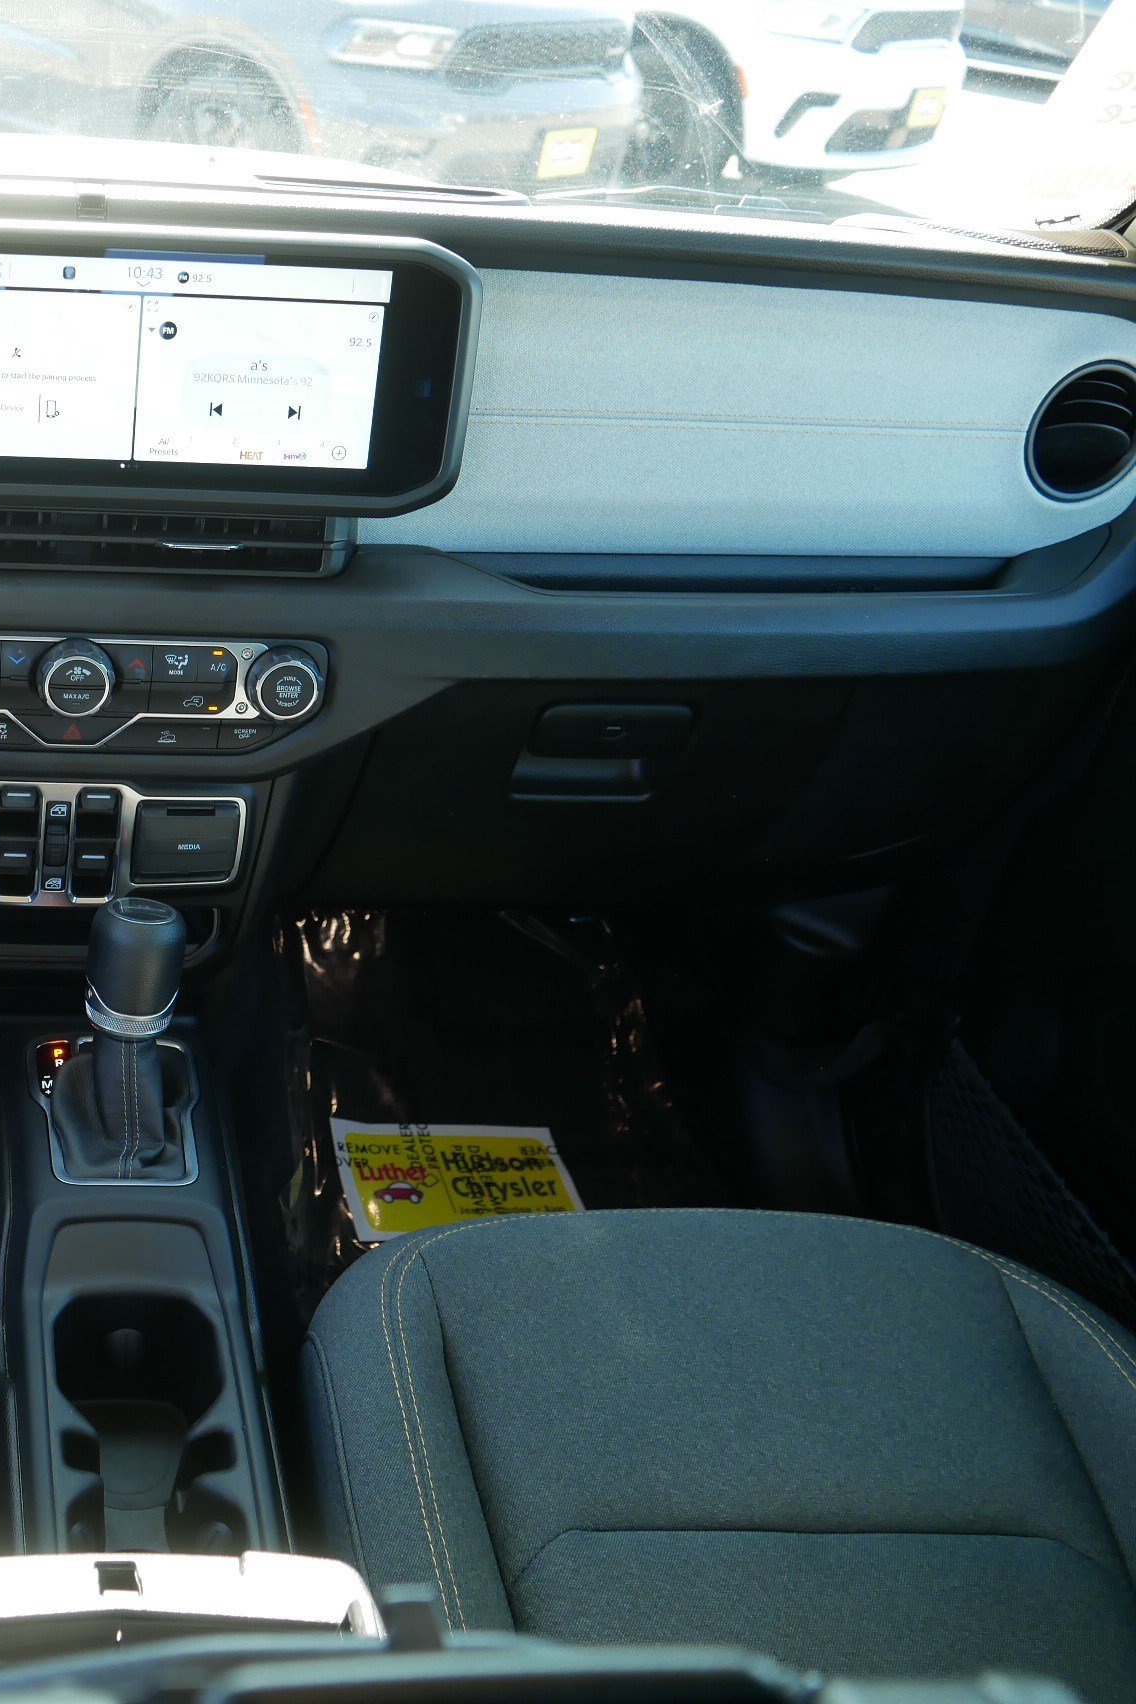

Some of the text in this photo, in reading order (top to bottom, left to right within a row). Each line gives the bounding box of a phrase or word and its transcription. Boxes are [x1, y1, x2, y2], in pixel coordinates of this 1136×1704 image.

[126, 266, 163, 280] 10:43
[191, 274, 212, 283] 92.5
[162, 326, 175, 335] FM
[349, 337, 372, 348] 92.5
[10, 372, 27, 381] start
[28, 372, 41, 381] the
[149, 447, 178, 457] Presets
[210, 663, 227, 673] A/C
[70, 674, 85, 683] OFF
[276, 684, 302, 693] BROWSE
[63, 692, 90, 701] MAX A/C
[278, 691, 299, 699] ENTER
[233, 728, 257, 736] SCREEN
[238, 733, 251, 741] OFF
[177, 843, 201, 851] MEDIA
[53, 1048, 64, 1058] P
[54, 1059, 64, 1067] R
[41, 1079, 53, 1090] M
[358, 1161, 428, 1182] Luther
